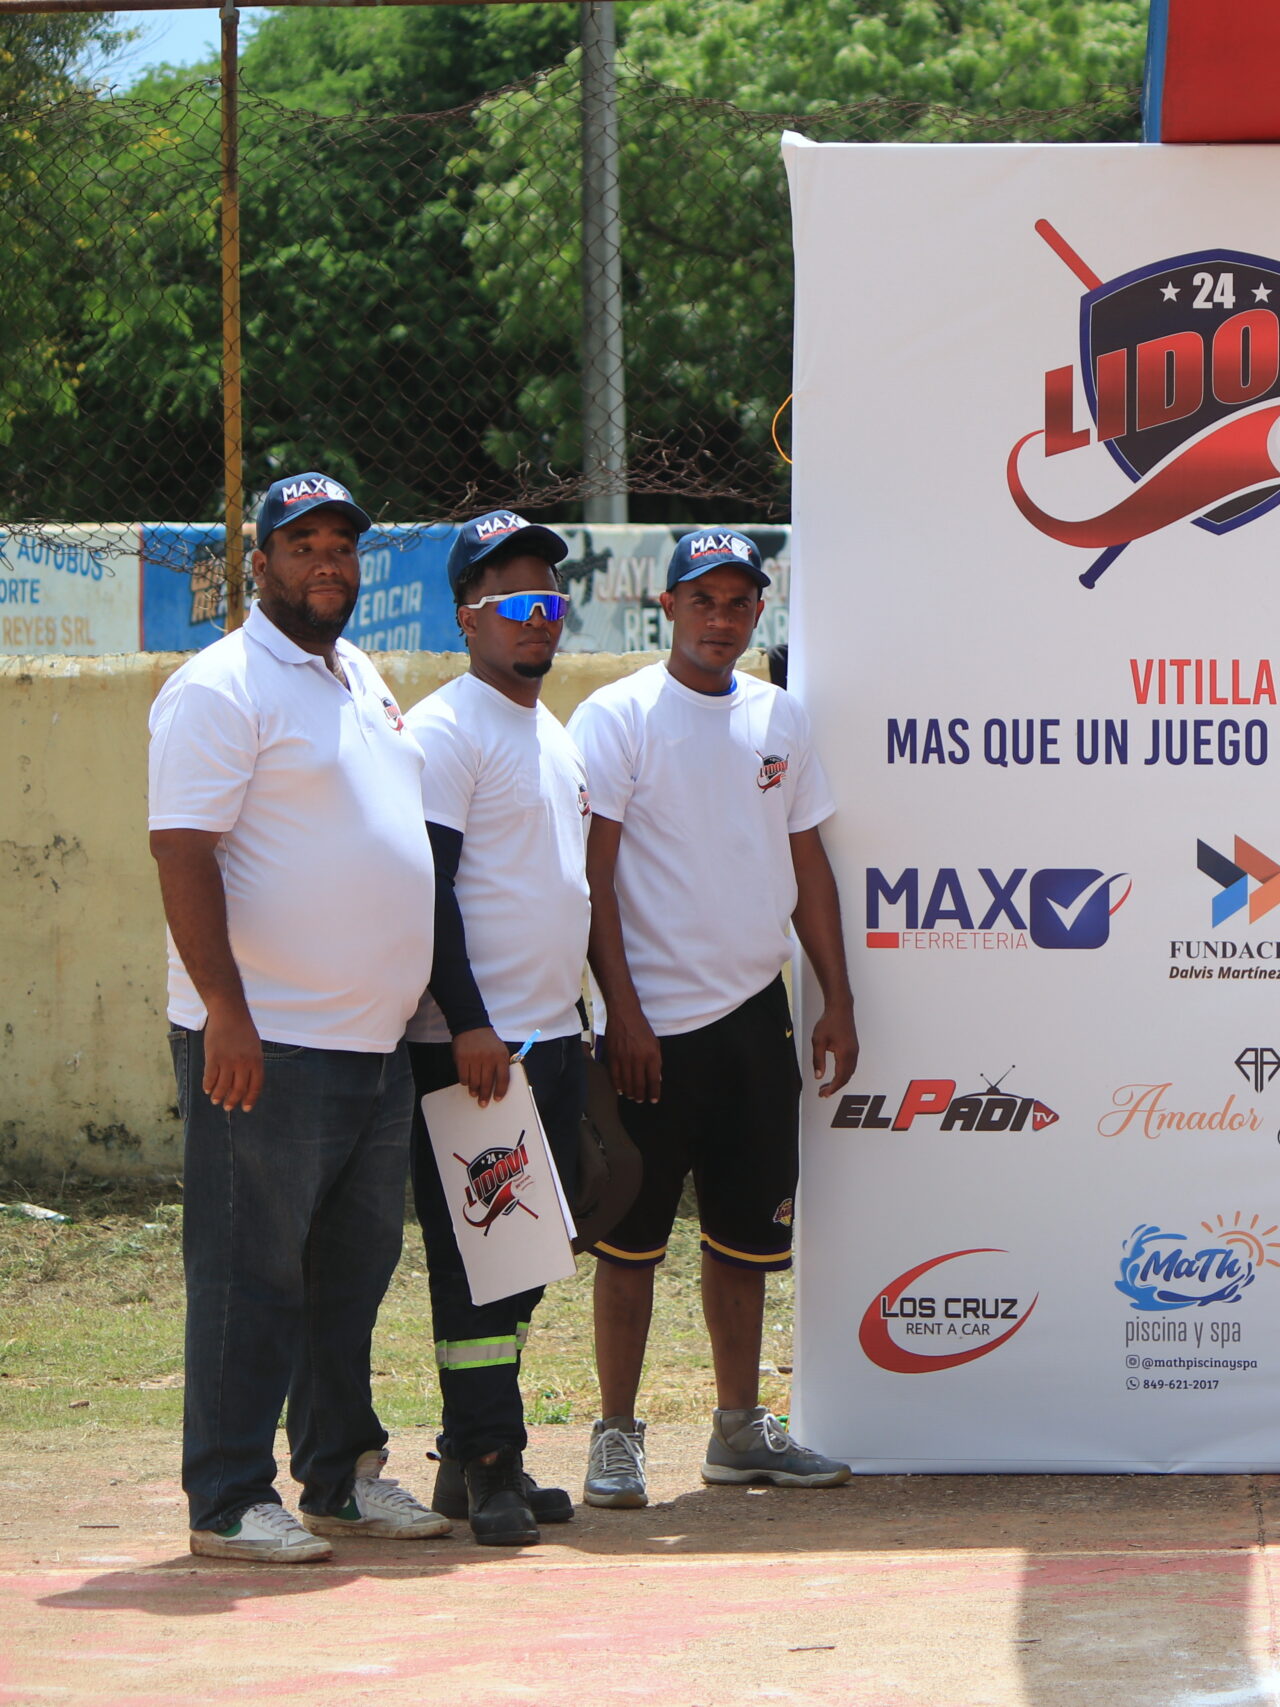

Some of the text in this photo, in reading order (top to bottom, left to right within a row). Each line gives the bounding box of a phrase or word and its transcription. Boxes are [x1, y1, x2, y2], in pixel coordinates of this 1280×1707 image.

[1192, 272, 1236, 309] 24
[282, 478, 326, 503] MAX
[475, 513, 520, 538] MAX
[690, 533, 733, 556] MAX
[17, 535, 104, 581] AUTOBUS
[2, 614, 97, 647] REYES SRL
[887, 718, 970, 765] MAS
[983, 718, 1061, 768] QUE
[1077, 718, 1129, 765] UN
[1144, 718, 1269, 766] JUEGO
[866, 867, 1029, 930] MAX
[901, 931, 1029, 950] FERRETERIA
[1168, 966, 1214, 980] Dalvis
[1034, 1111, 1054, 1123] TV
[1096, 1082, 1264, 1140] Amador
[464, 1143, 529, 1208] LIDOVI
[1139, 1248, 1242, 1283] MaTh
[882, 1297, 1018, 1319] LOS CRUZ
[906, 1322, 991, 1336] RENT A CAR
[1125, 1316, 1242, 1349] piscina y spa
[1141, 1357, 1258, 1371] @mathpiscinayspa
[1143, 1379, 1220, 1390] 849-621-2017
